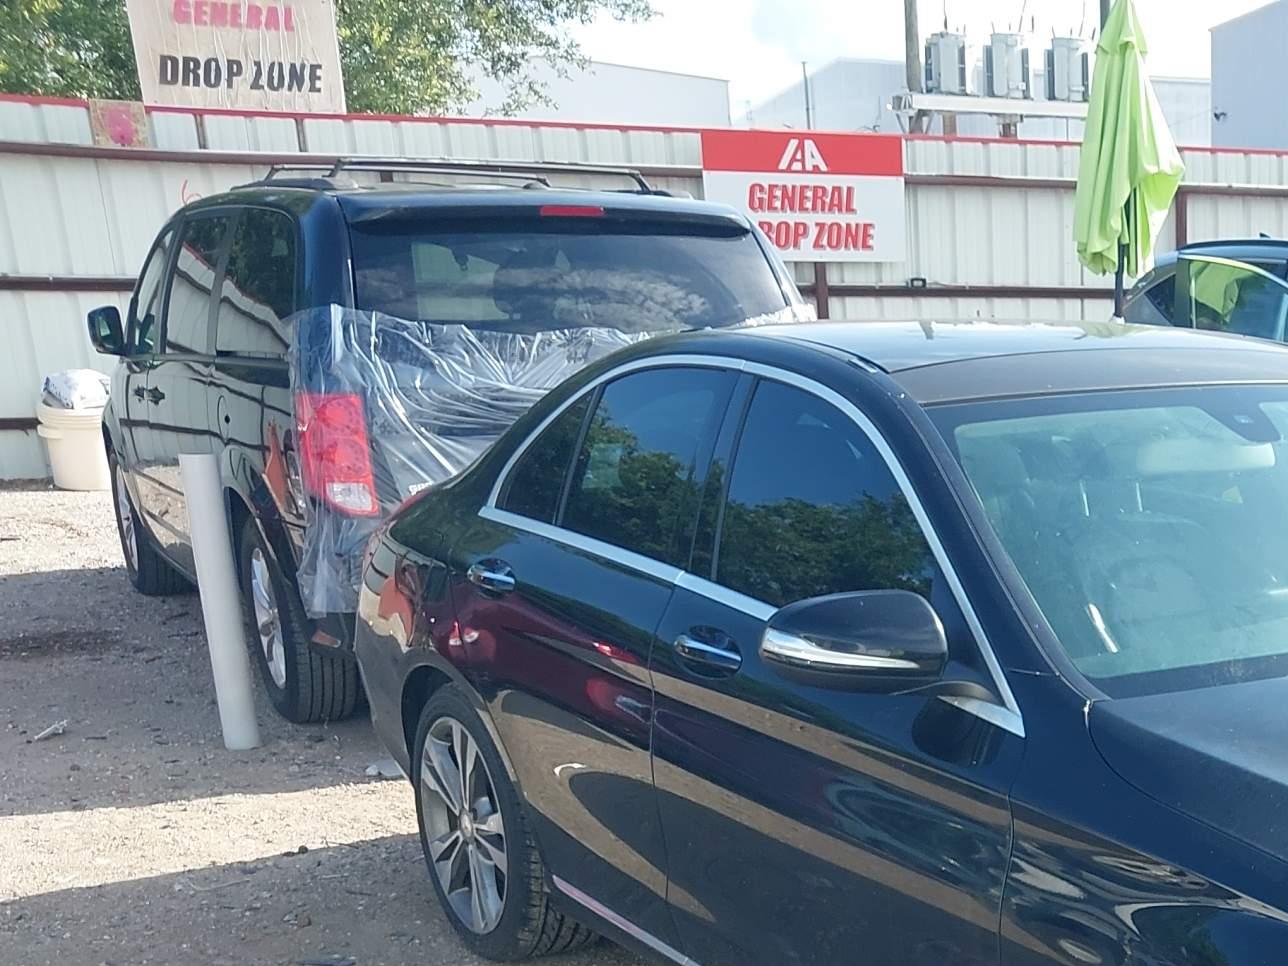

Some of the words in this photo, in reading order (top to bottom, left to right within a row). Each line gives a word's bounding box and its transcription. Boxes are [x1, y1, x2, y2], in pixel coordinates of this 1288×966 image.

[173, 0, 296, 33] GENERAL
[159, 54, 243, 89] DROP
[250, 60, 323, 93] ZONE
[748, 182, 858, 214] GENERAL
[758, 220, 810, 251] ROP
[812, 222, 876, 251] ZONE
